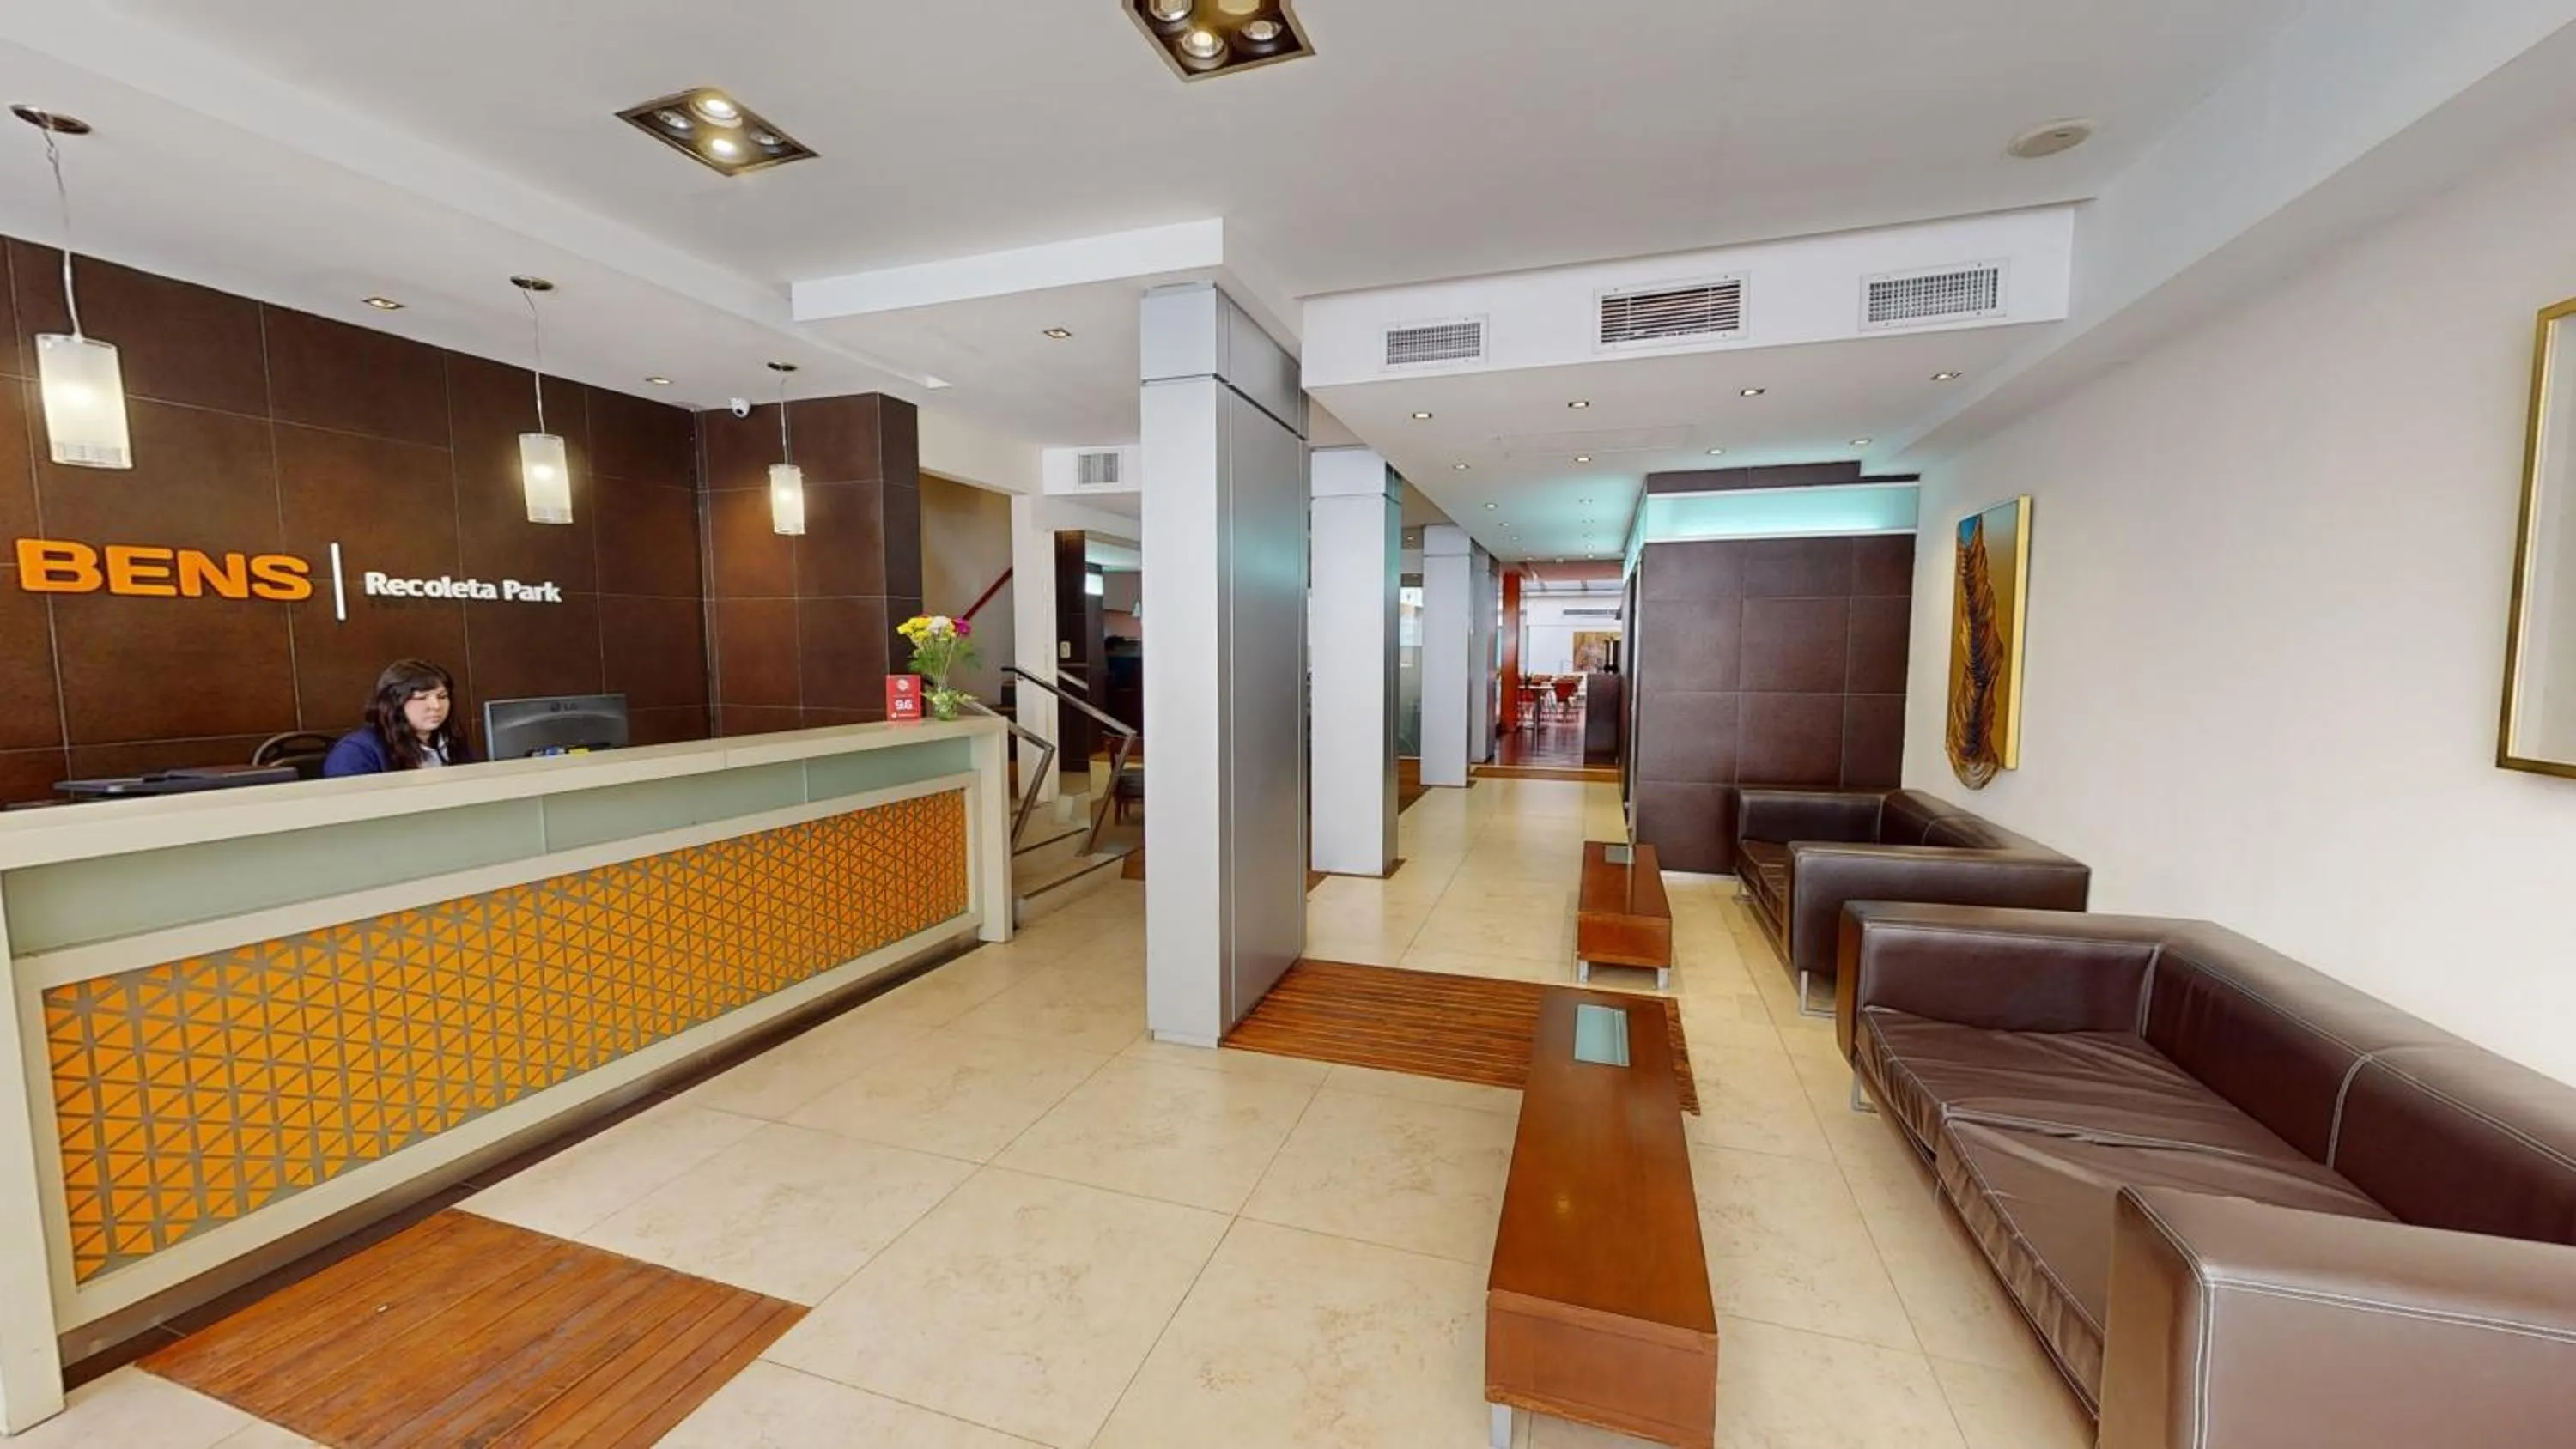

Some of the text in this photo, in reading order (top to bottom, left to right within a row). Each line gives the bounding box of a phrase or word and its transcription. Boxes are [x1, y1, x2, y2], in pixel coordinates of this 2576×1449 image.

[16, 538, 313, 600] BENS
[364, 571, 562, 603] Recoleta Park
